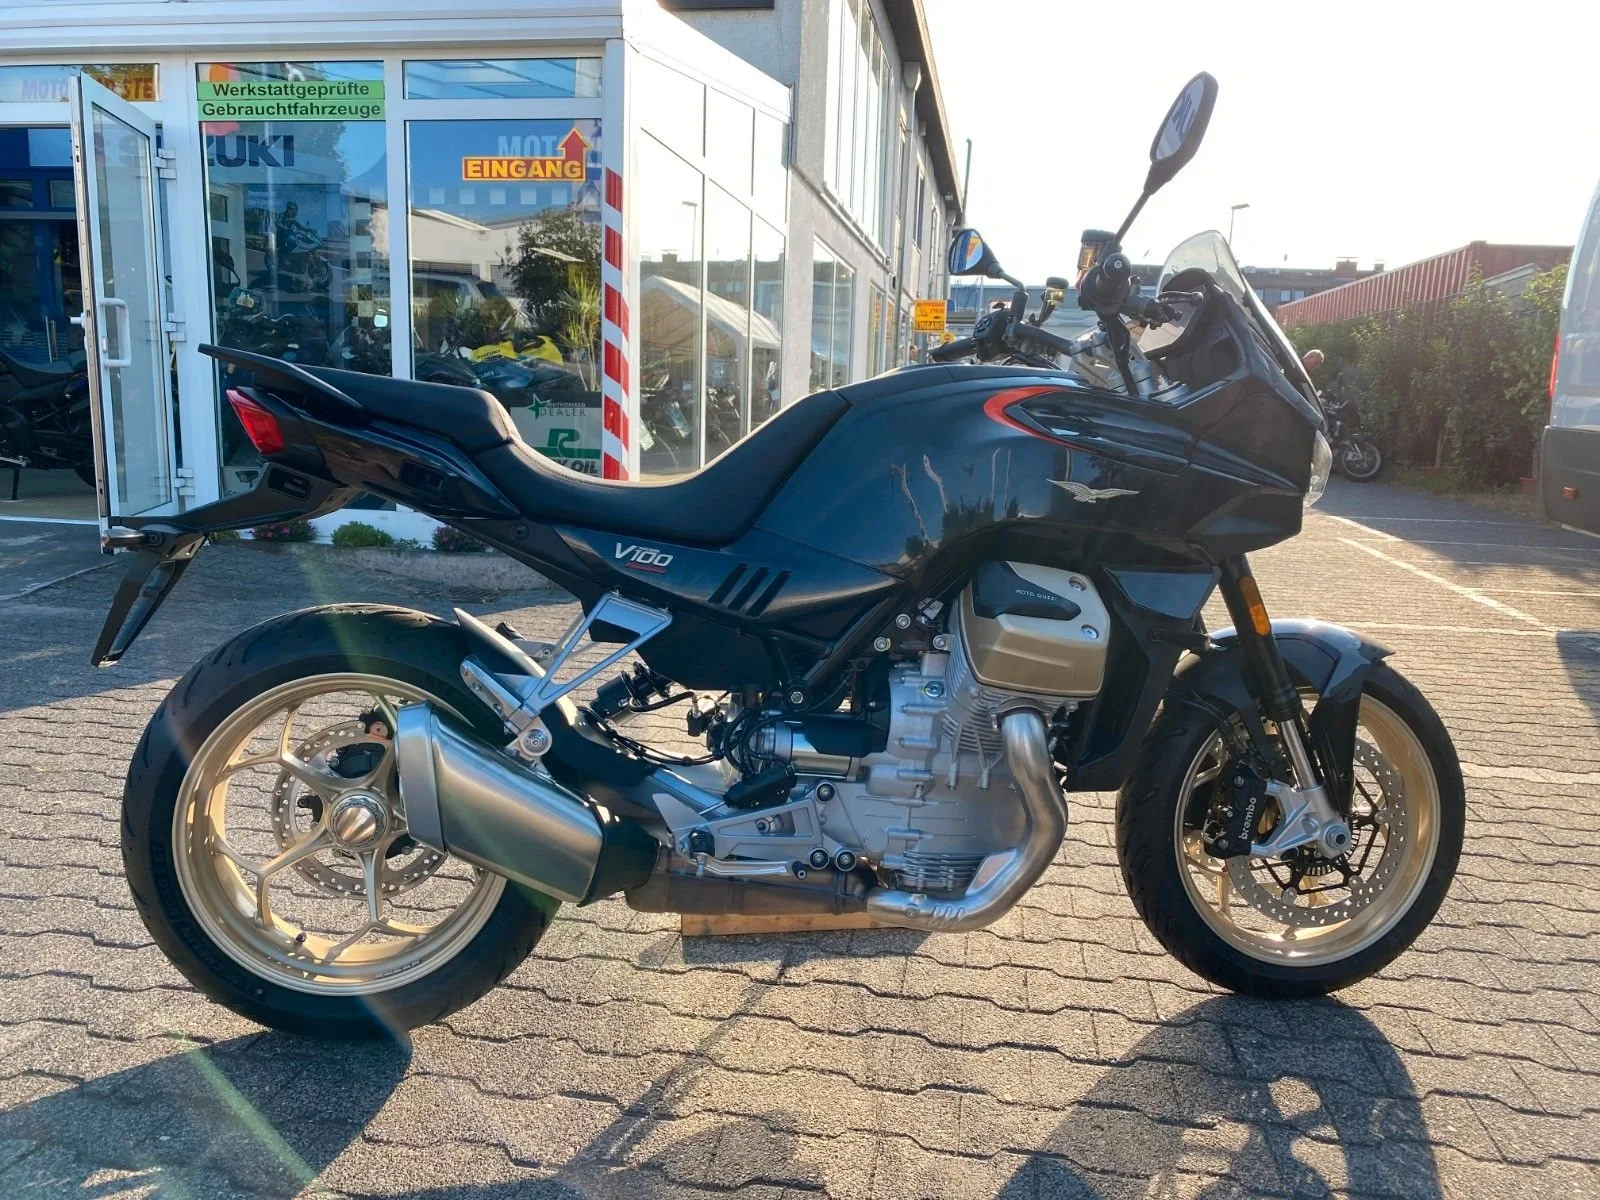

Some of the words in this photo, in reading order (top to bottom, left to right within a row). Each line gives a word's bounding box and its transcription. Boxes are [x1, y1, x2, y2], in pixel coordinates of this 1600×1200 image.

[213, 82, 369, 99] Werkstattgeprüfte
[202, 103, 381, 118] Gebrauchtfahrzeuge
[466, 160, 581, 178] EINGANG
[540, 408, 586, 416] DEALER
[615, 542, 674, 567] V100
[1015, 589, 1035, 597] MOTO
[1036, 593, 1057, 601] GUZZI
[1238, 797, 1257, 840] brembo
